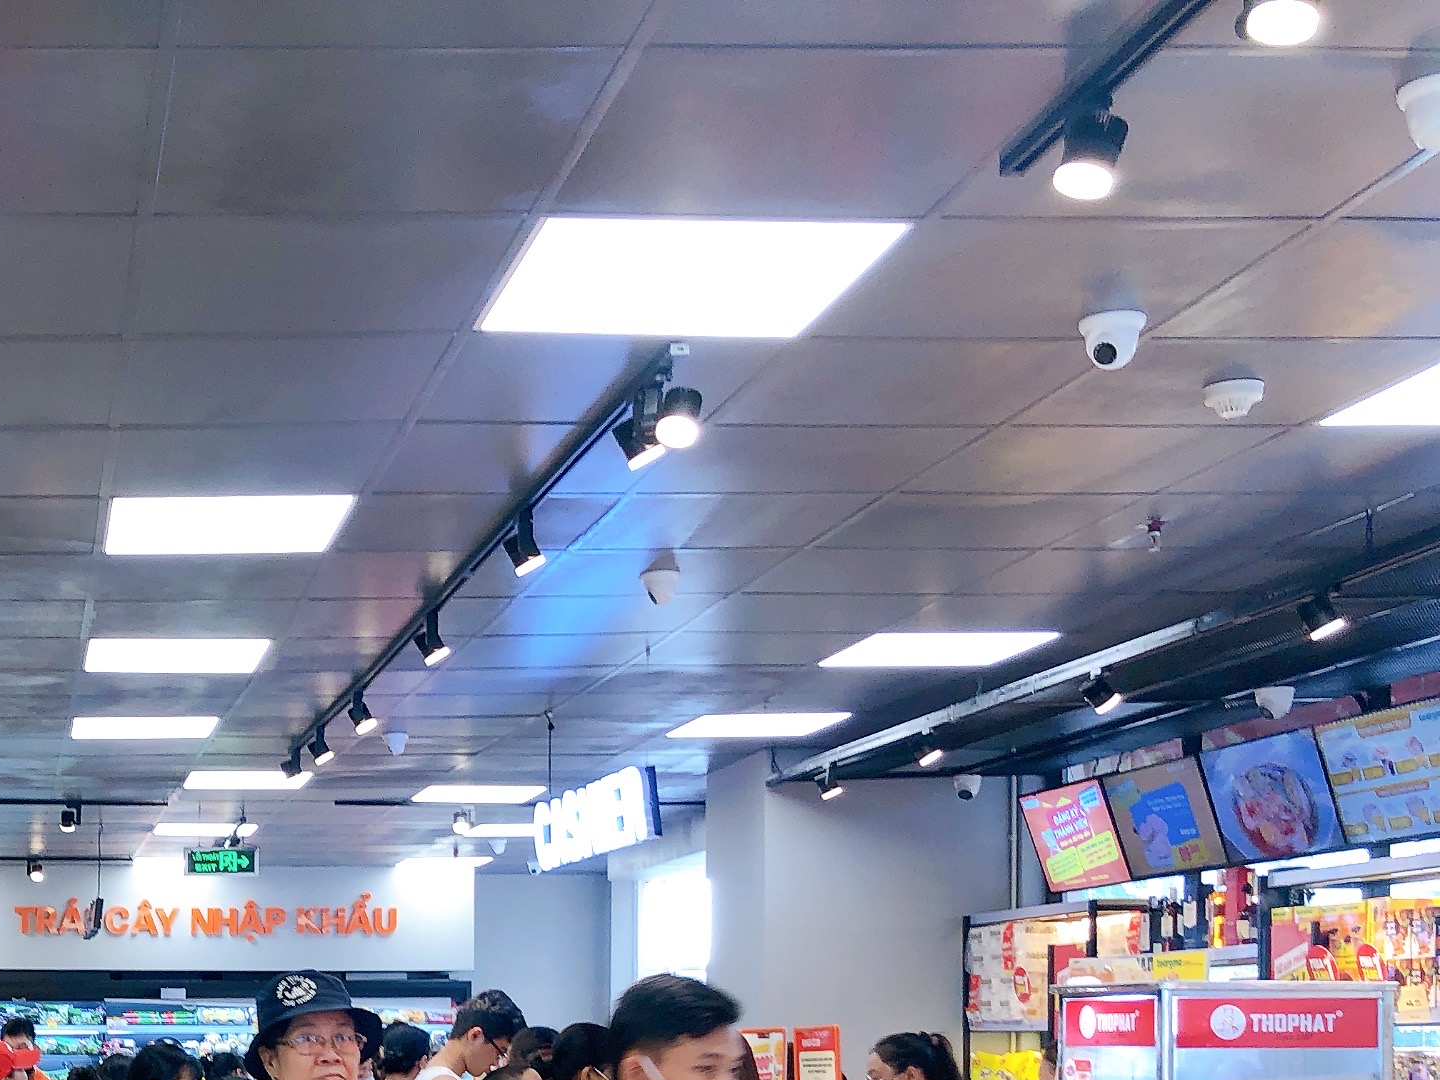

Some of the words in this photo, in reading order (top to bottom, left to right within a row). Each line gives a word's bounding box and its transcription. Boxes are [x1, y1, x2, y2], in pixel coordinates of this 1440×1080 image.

[14, 897, 87, 937] TRÁ
[104, 899, 179, 938] CÂY
[191, 899, 287, 942] NHẬP
[296, 892, 399, 937] KHẨU
